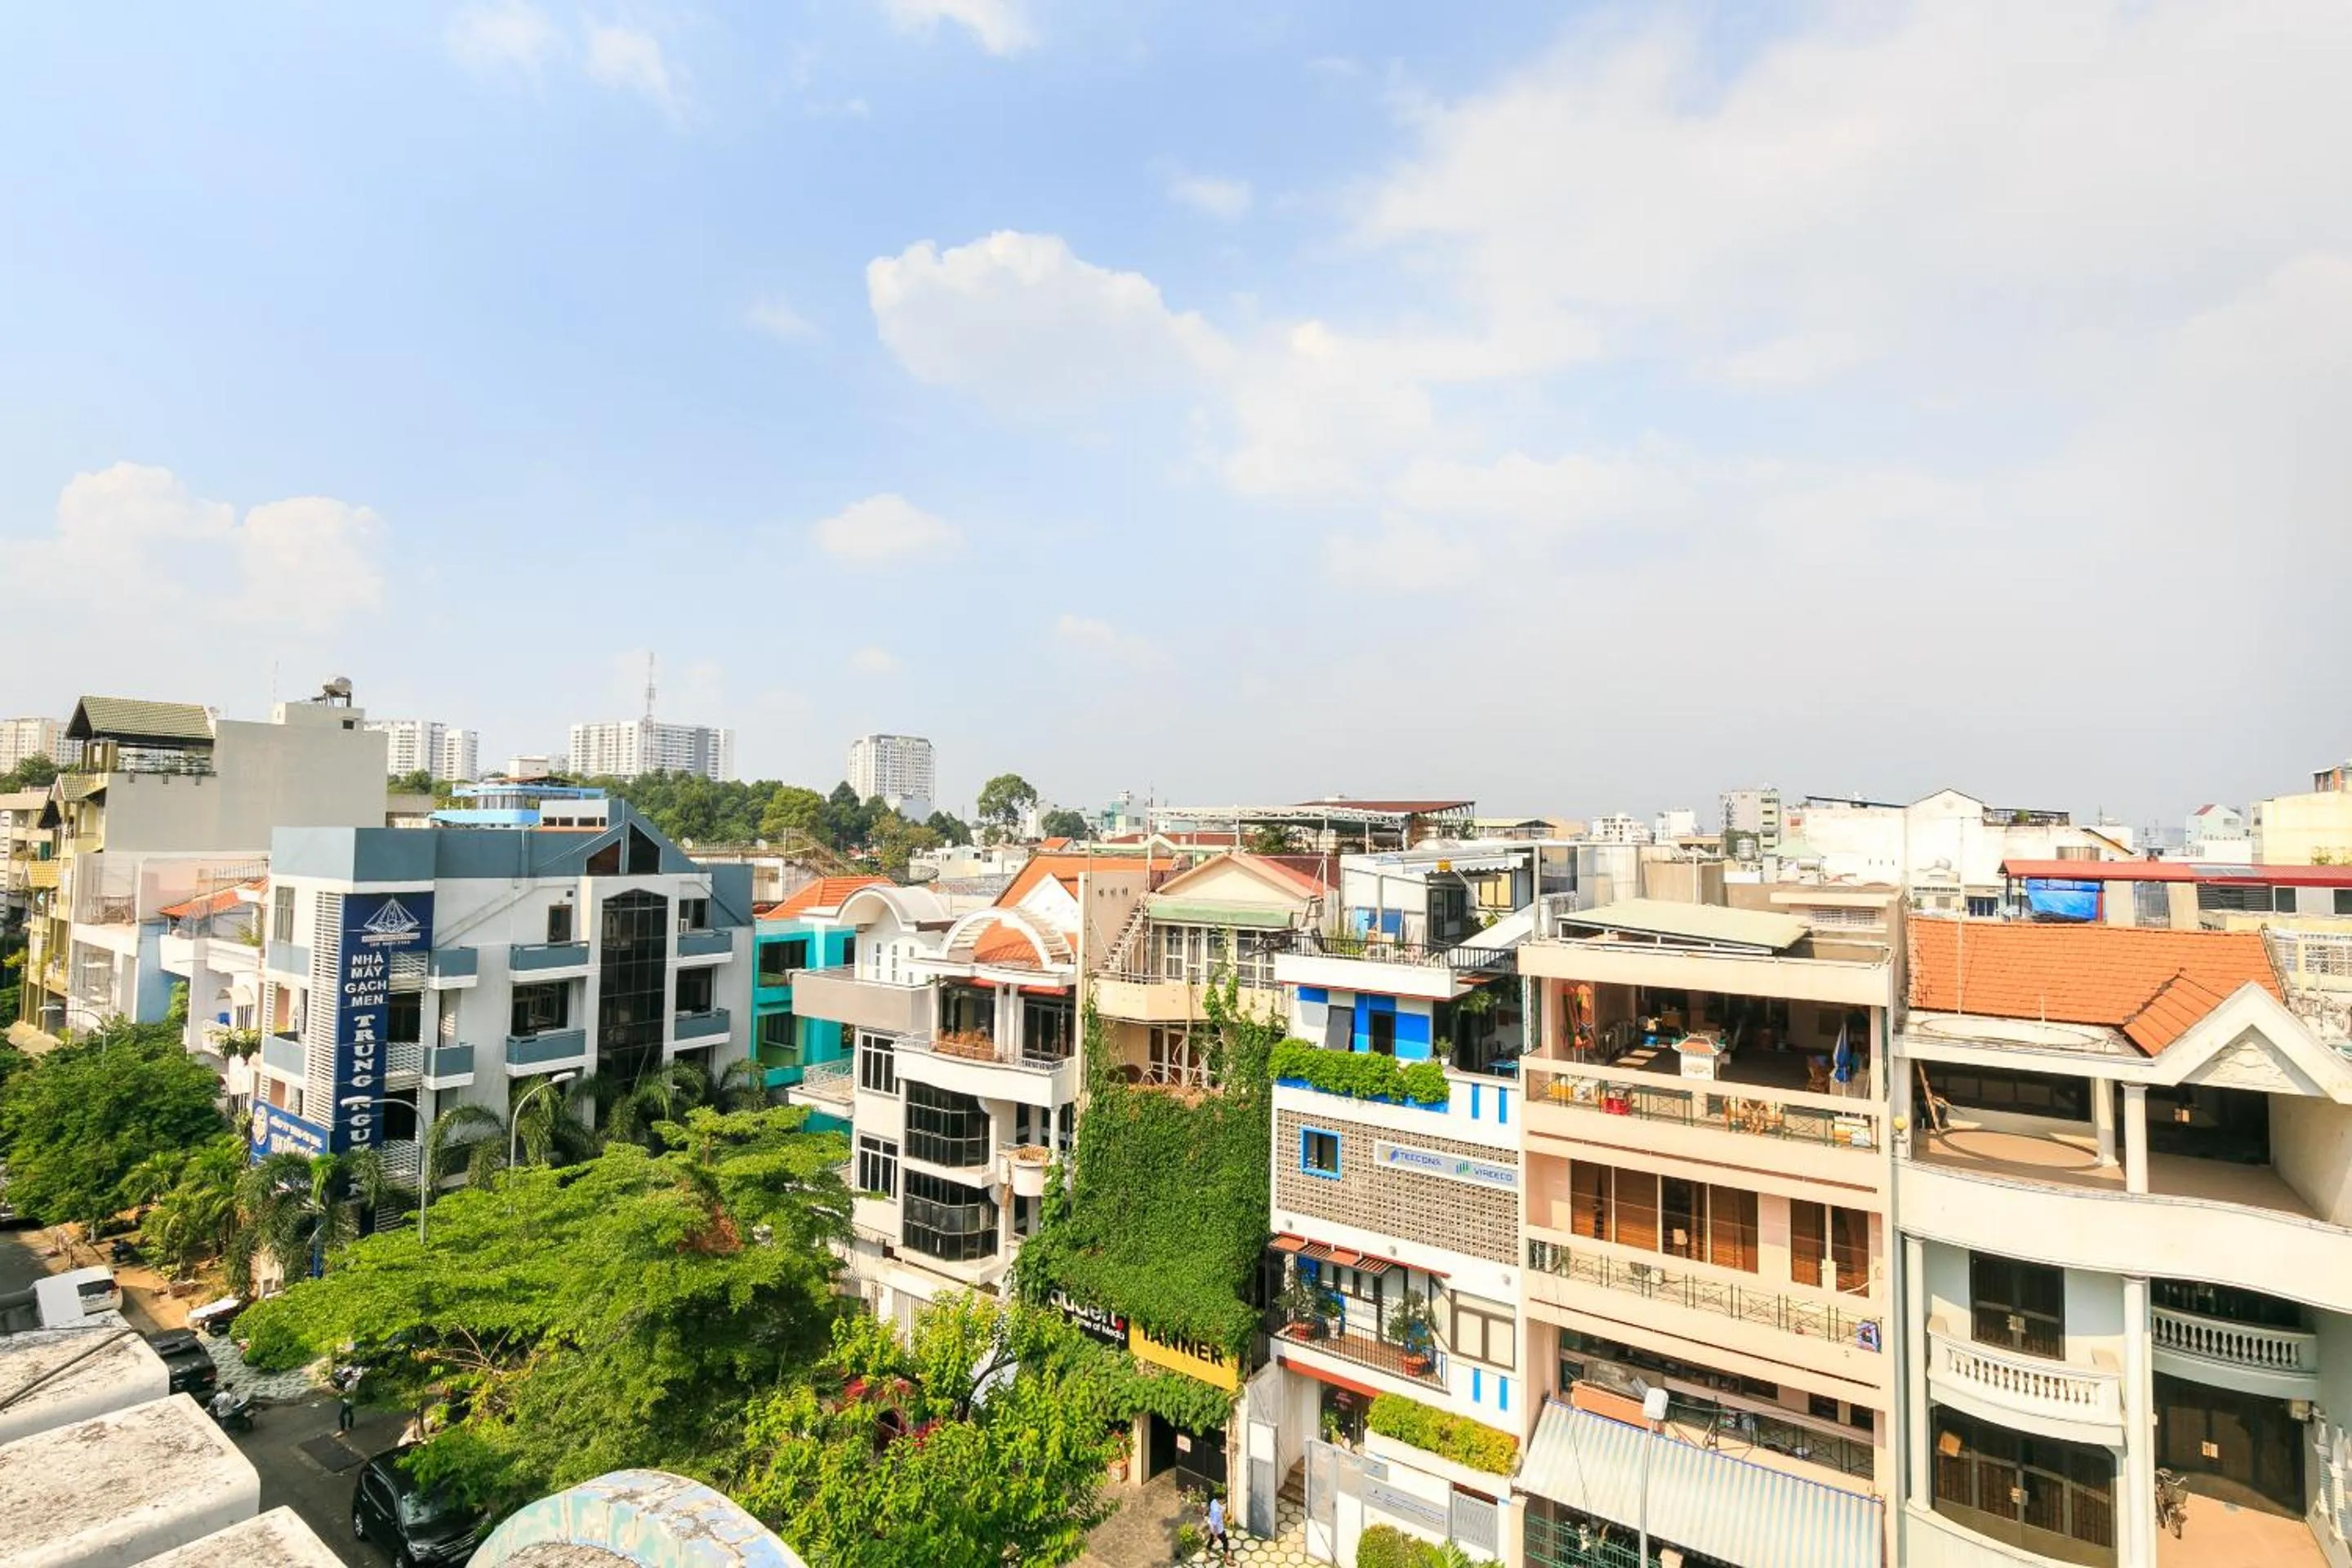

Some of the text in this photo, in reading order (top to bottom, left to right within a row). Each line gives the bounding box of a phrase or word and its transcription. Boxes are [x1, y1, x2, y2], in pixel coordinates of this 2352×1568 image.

[352, 951, 384, 965] NHÀ
[350, 964, 383, 979] MÁY
[345, 980, 386, 995] GẠCH
[351, 994, 384, 1007] MEN
[351, 1014, 376, 1087] TRUNG
